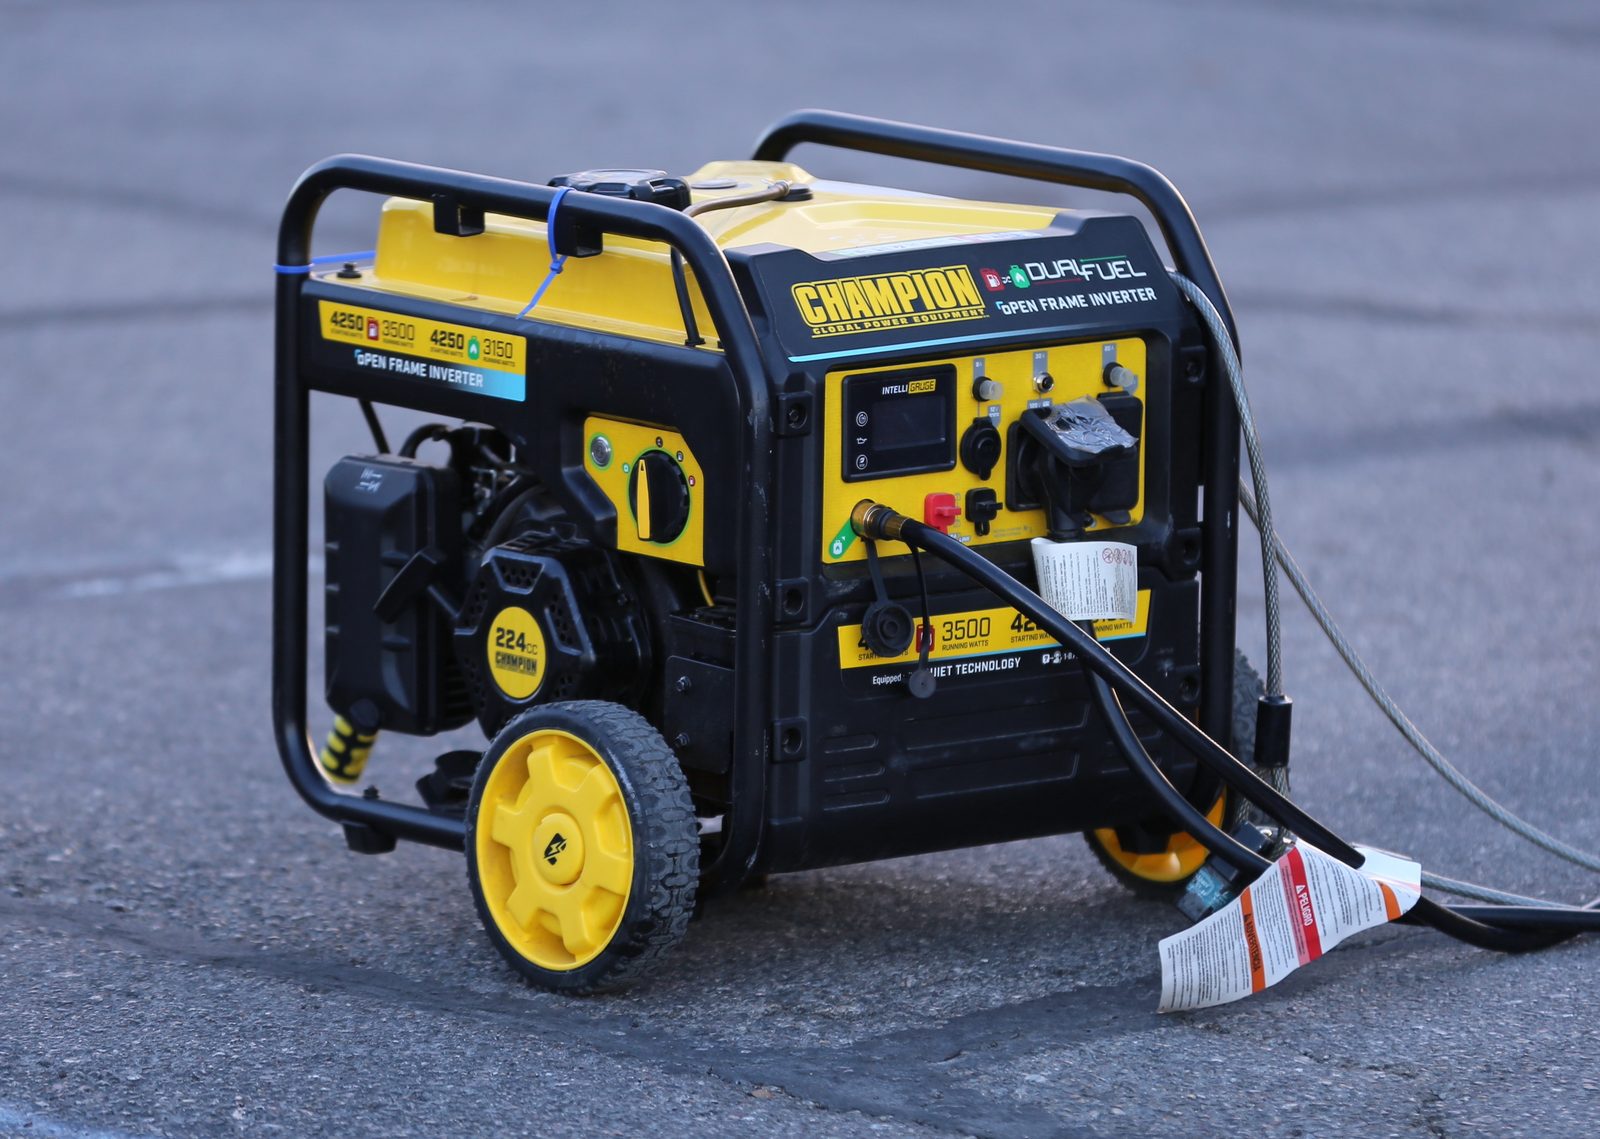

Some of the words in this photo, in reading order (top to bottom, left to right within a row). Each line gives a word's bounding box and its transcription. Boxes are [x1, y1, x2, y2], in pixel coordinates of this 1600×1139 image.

[792, 265, 985, 326] CHAMPION
[1001, 299, 1039, 315] OPEN
[1040, 293, 1086, 311] FRAME
[1088, 287, 1157, 306] INVERTER
[330, 311, 364, 331] 4250
[382, 319, 415, 341] 3500
[430, 329, 465, 350] 4250
[483, 338, 513, 359] 3150
[812, 322, 866, 335] GLOBAL
[865, 317, 909, 329] POWER
[914, 308, 985, 323] EQUIPMENT
[356, 352, 387, 369] OPEN
[388, 357, 428, 377] FRAME
[429, 365, 484, 388] INVERTER
[941, 617, 991, 642] 3500
[1010, 612, 1037, 632] 42
[942, 641, 968, 651] RUNNING
[969, 639, 989, 648] WATTS
[872, 673, 902, 685] Equipped
[930, 665, 953, 678] UIET
[955, 657, 1021, 675] TECHNOLOGY
[1299, 892, 1313, 927] PELIGRO
